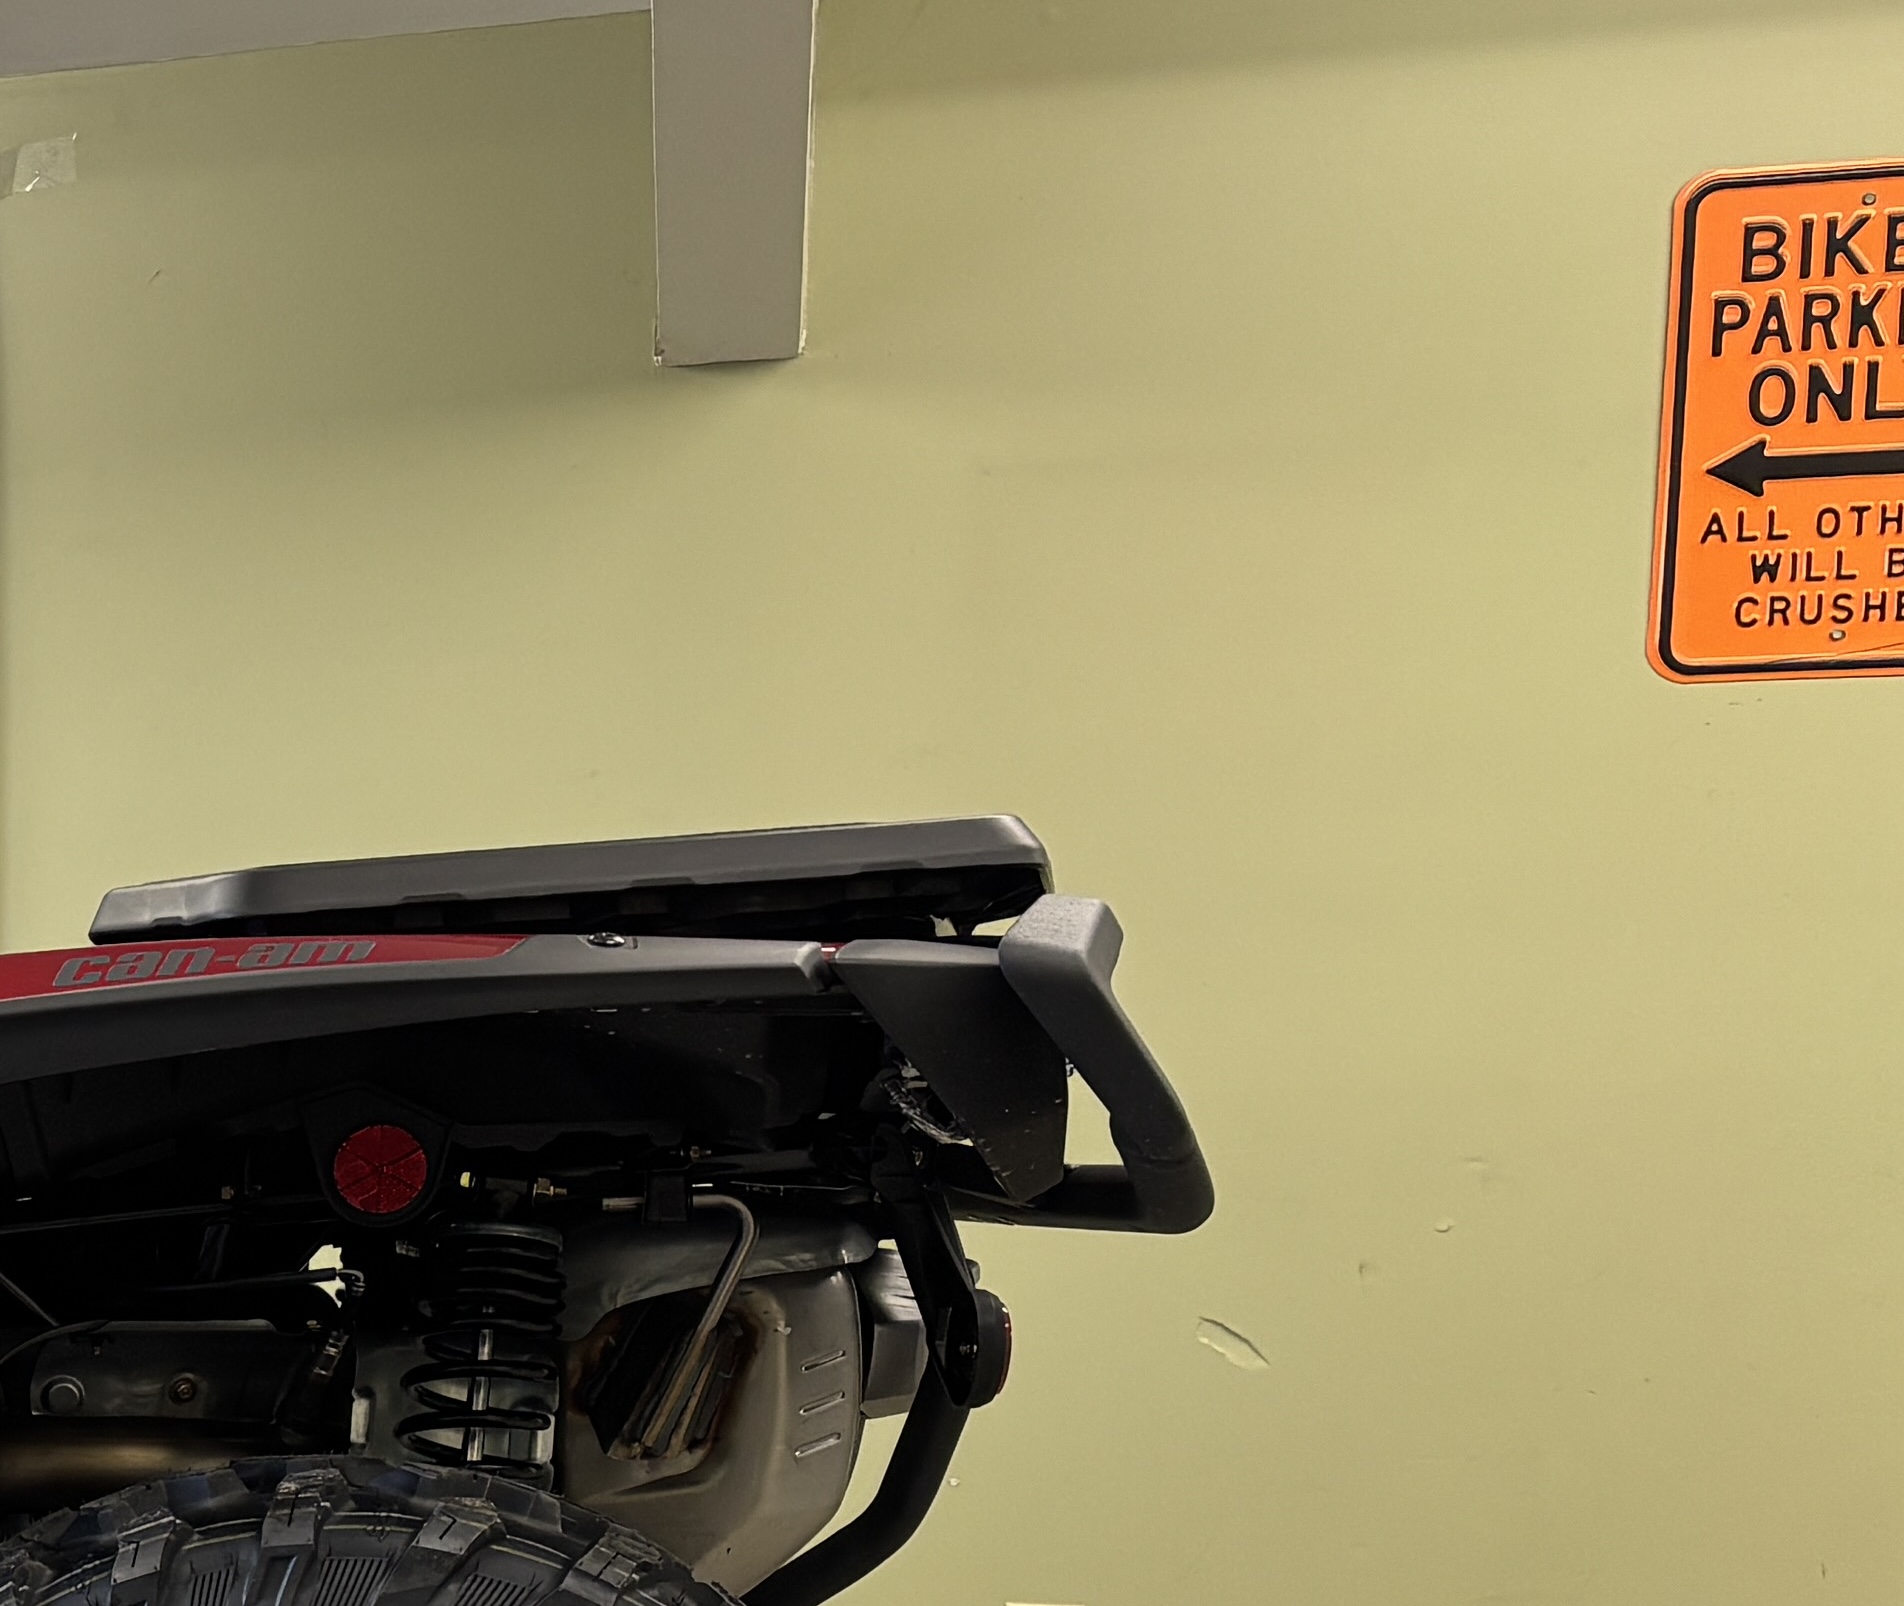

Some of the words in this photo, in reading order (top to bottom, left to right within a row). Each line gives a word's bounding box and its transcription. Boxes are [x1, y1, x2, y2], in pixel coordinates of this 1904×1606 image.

[1700, 508, 1789, 544] ALL
[1751, 549, 1857, 584] WILL
[50, 936, 378, 990] can-am
